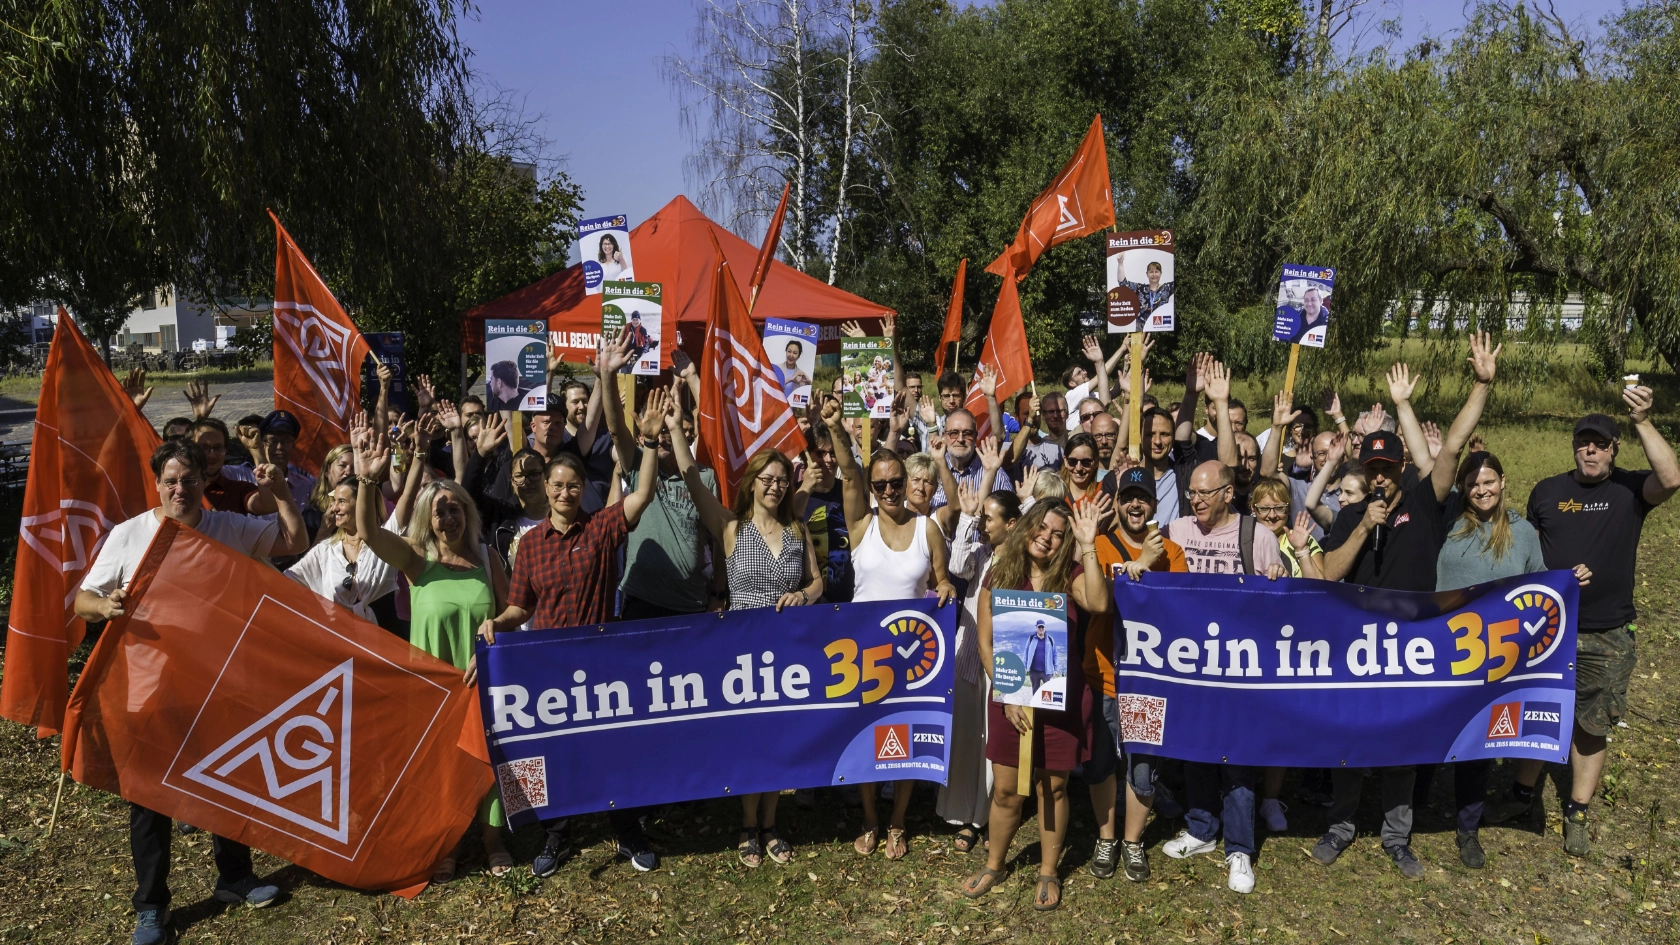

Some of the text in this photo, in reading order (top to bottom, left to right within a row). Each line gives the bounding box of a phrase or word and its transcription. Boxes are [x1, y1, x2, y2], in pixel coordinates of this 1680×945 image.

[580, 224, 594, 232] Rein
[602, 220, 612, 228] die
[1109, 238, 1128, 246] Rein
[1130, 237, 1138, 245] in
[1140, 236, 1153, 244] die
[1284, 268, 1299, 276] Rein
[1308, 270, 1318, 278] die
[605, 286, 622, 294] Rein
[632, 287, 644, 295] die
[767, 322, 782, 331] Rein
[792, 326, 802, 334] die
[548, 331, 568, 347] TALL
[995, 596, 1016, 606] Rein
[1018, 598, 1027, 606] in
[1029, 598, 1043, 608] die
[1120, 612, 1520, 682] Rein in die 35
[488, 638, 895, 732] Rein in die 35
[1524, 711, 1559, 723] ZEISS
[914, 733, 944, 744] ZEISS
[1540, 743, 1559, 751] BERLIN
[930, 763, 944, 771] BERLIN
